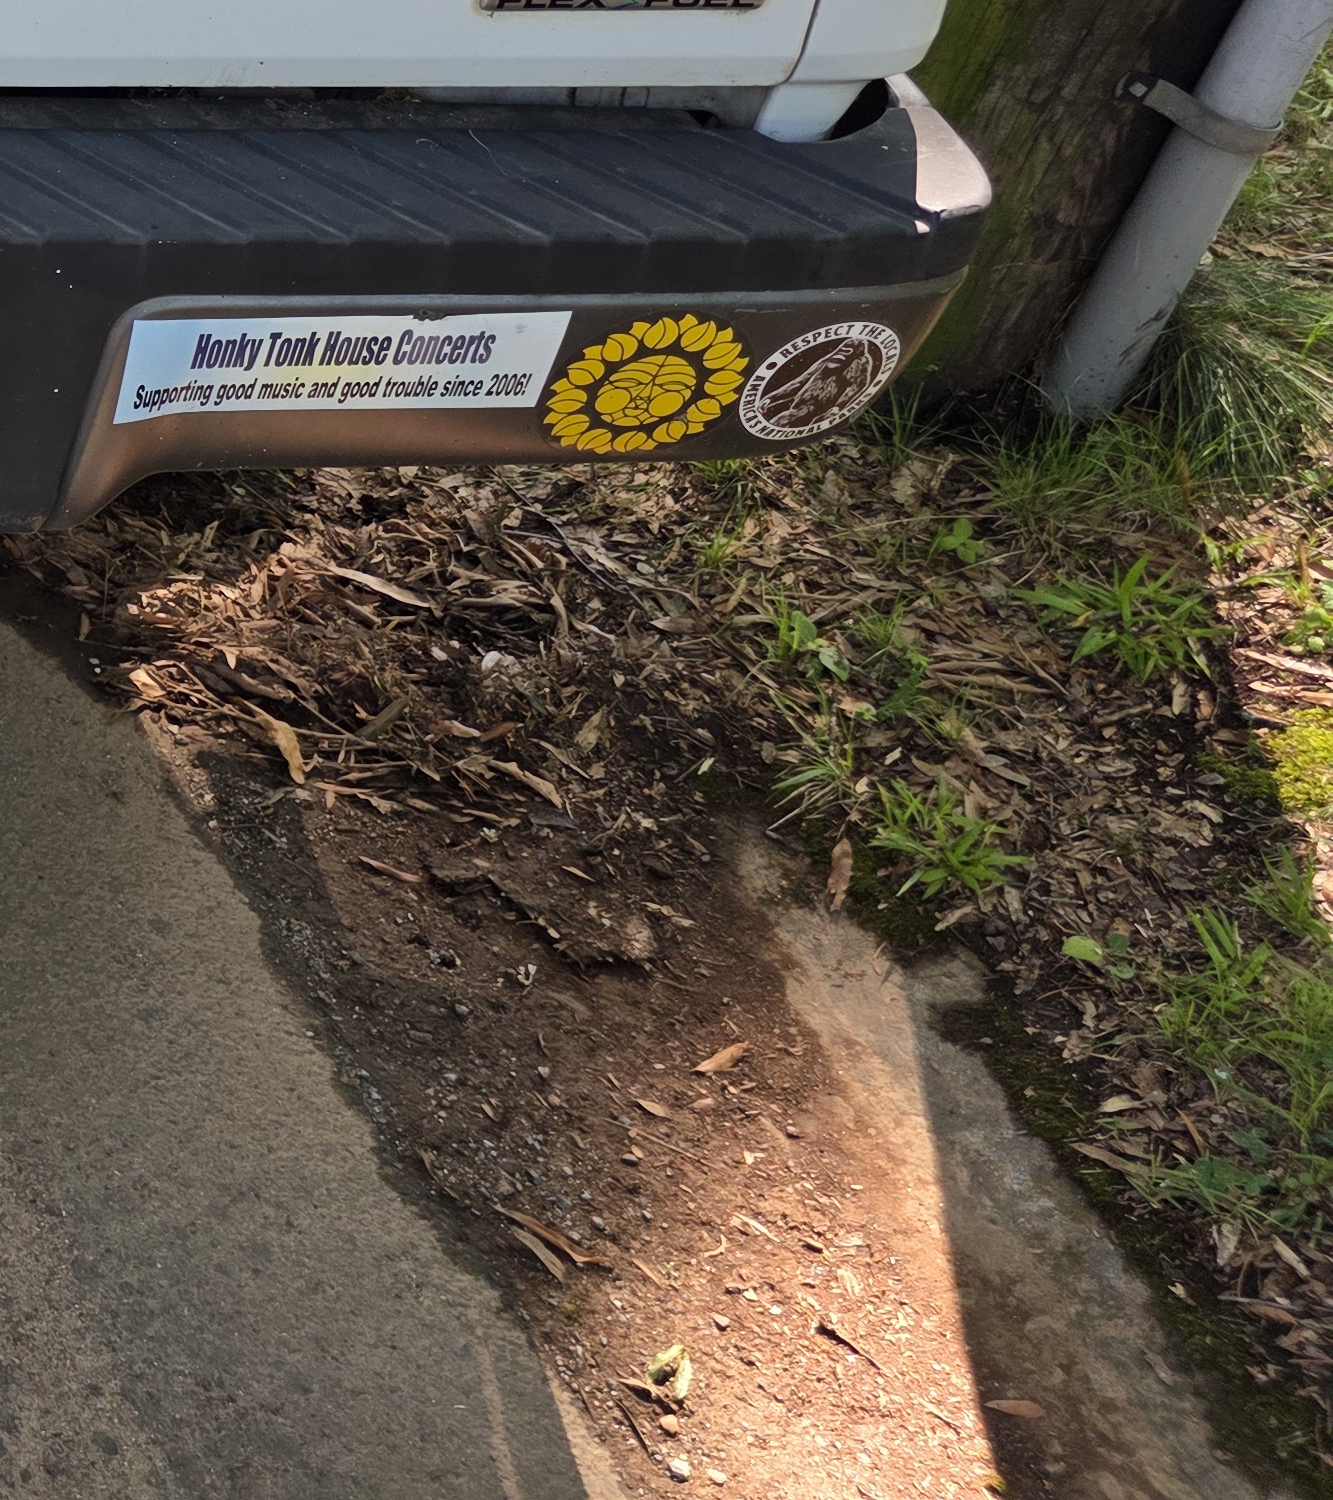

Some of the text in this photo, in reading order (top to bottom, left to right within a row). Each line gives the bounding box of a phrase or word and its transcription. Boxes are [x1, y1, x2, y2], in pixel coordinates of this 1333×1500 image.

[190, 329, 497, 371] Honky Tonk House Concerts
[780, 324, 899, 375] RESPECT THE LOCALS
[133, 372, 533, 412] Supporting good music and good trouble since 2006!
[742, 374, 873, 439] AMERICA'S NATIONAL PARKS
